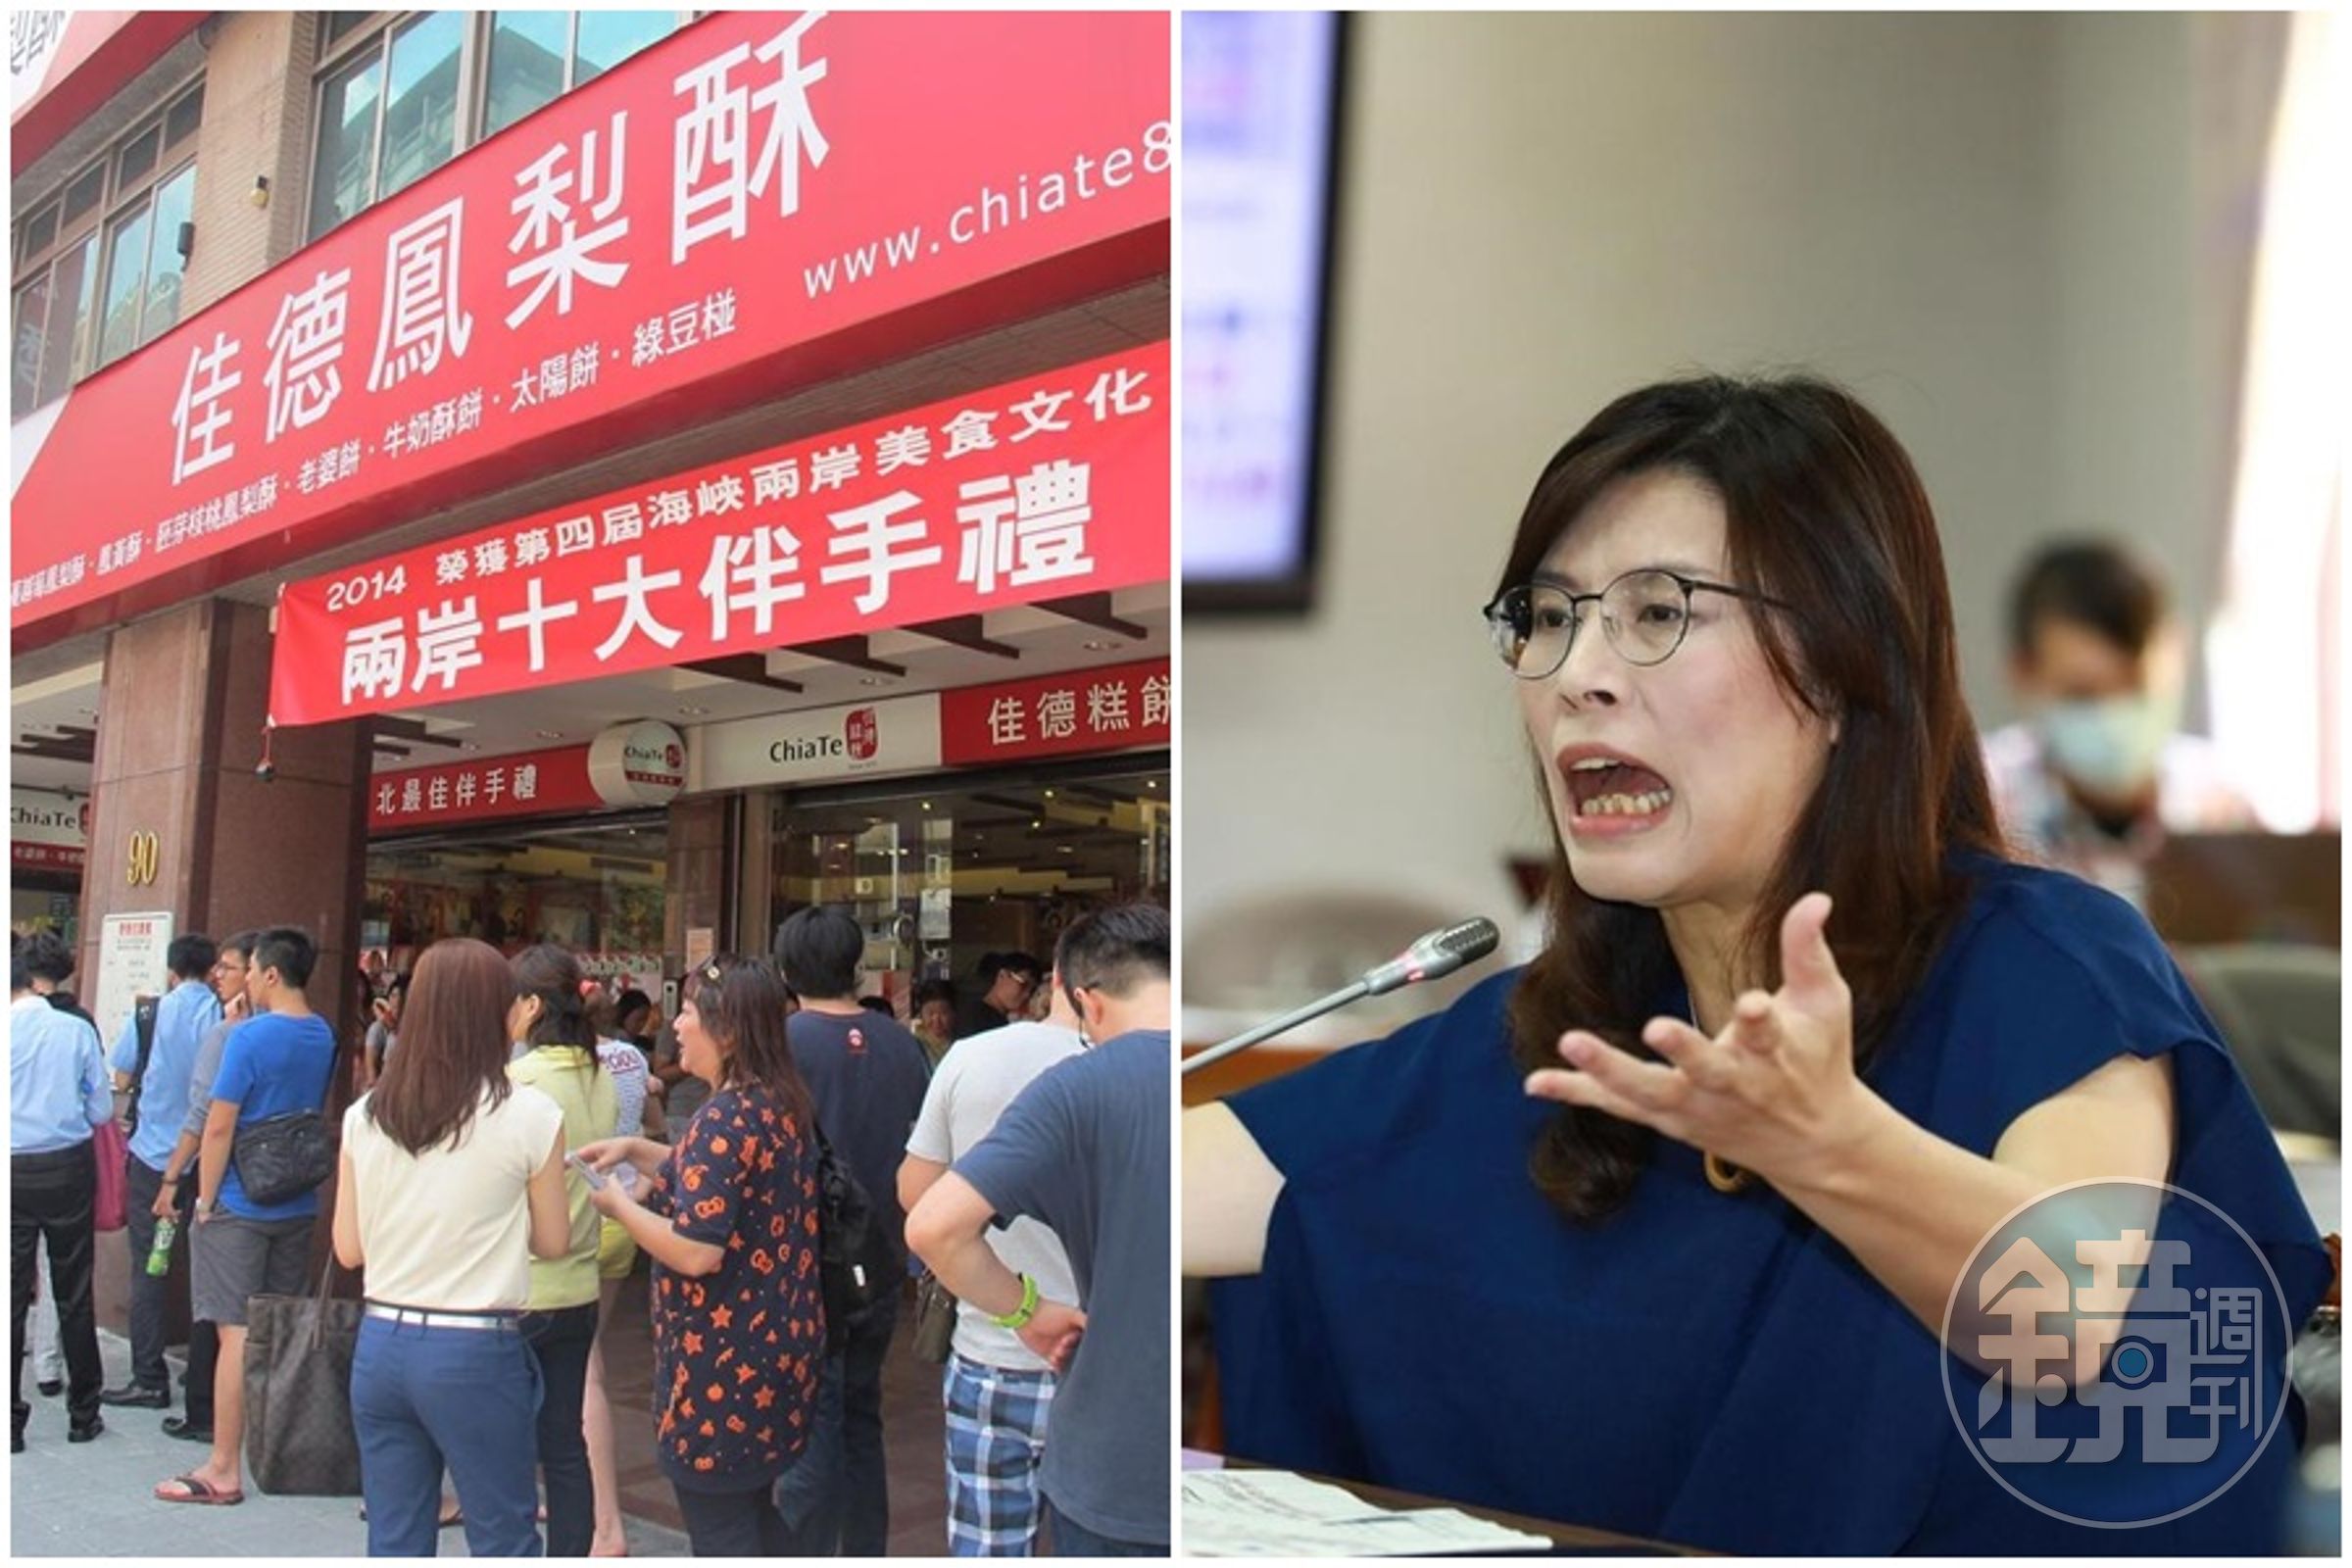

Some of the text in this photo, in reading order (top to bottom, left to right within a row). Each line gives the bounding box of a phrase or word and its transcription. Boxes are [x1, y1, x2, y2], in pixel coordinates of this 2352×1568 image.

[171, 11, 830, 486] 佳德鳳梨酥
[804, 120, 1171, 299] www.chiate8
[435, 367, 1152, 586] 榮獲第四屆海峽兩岸美食文化
[326, 564, 408, 612] 2014
[341, 458, 1096, 707] 兩岸十大伴手禮
[375, 763, 538, 815] 北最佳伴手禮
[769, 734, 843, 763] ChiaTe
[127, 830, 158, 885] 90
